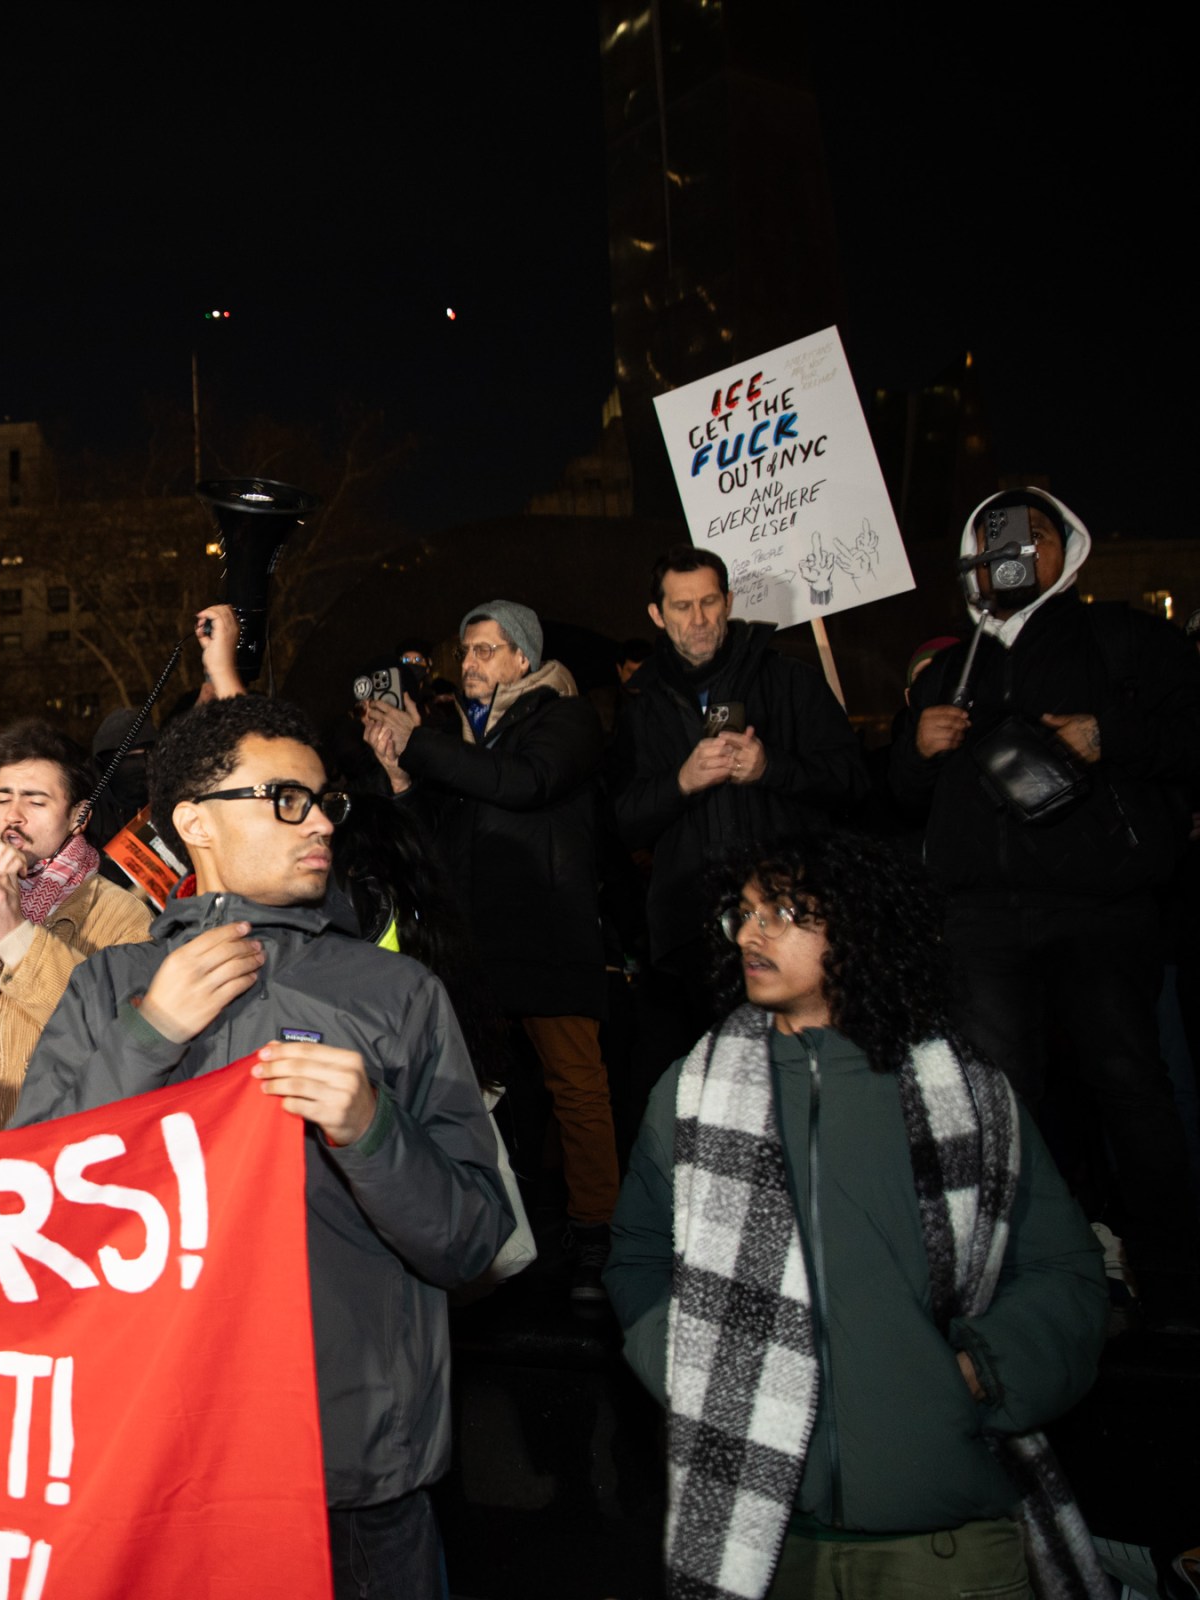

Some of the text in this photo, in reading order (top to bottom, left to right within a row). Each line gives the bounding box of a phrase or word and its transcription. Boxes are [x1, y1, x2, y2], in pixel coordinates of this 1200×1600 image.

[689, 388, 795, 449] GET THE
[691, 412, 799, 477] FUCK
[718, 455, 765, 494] OUT
[779, 435, 828, 470] NYC
[750, 481, 784, 505] AND
[707, 478, 827, 539] EVERYWHERE
